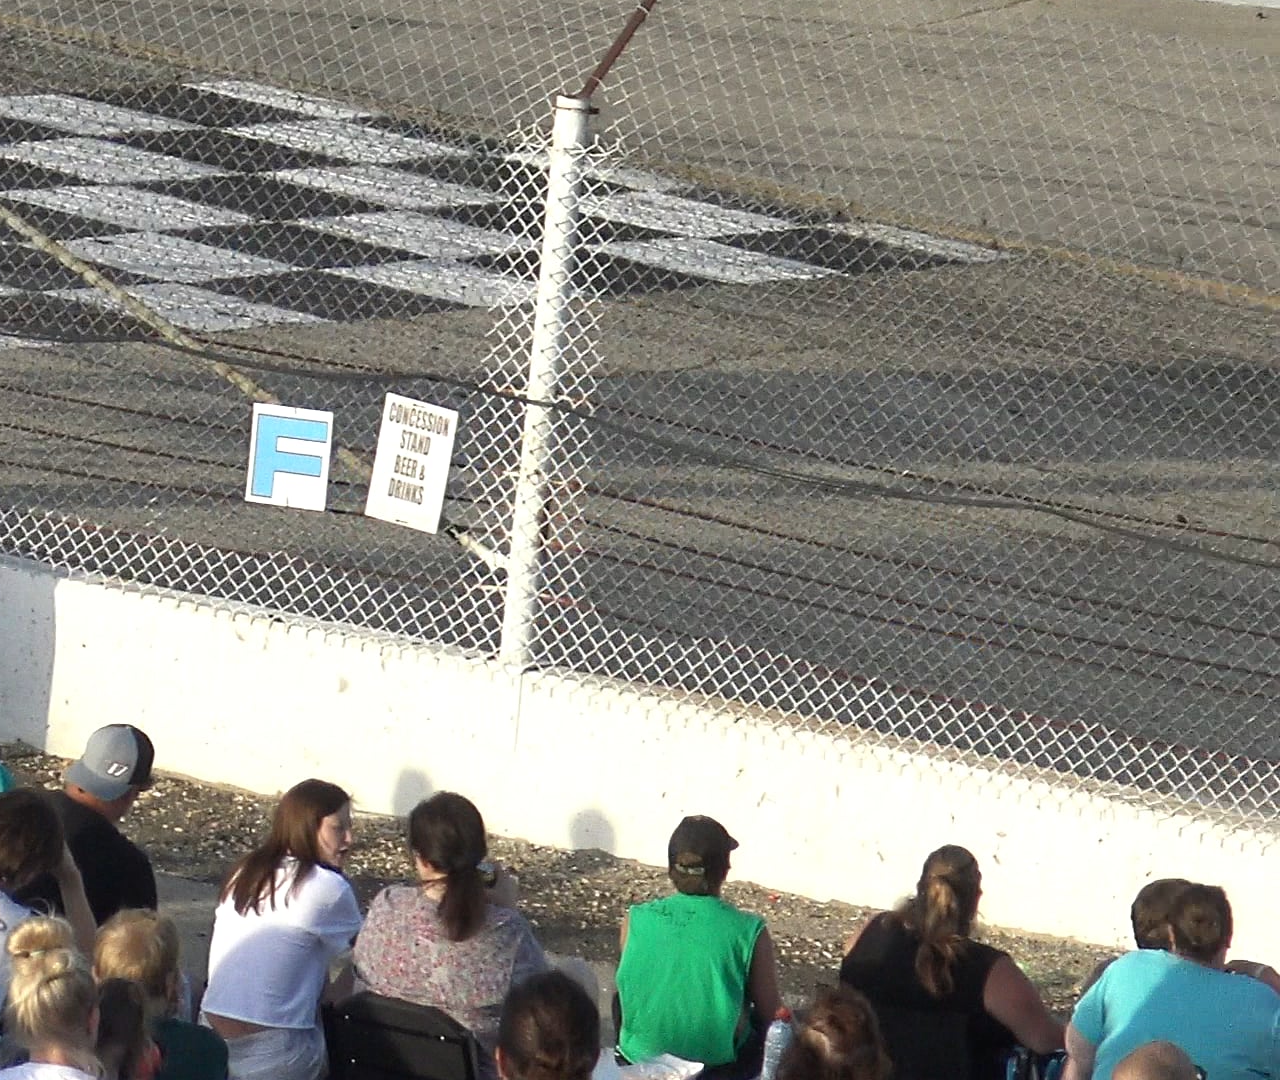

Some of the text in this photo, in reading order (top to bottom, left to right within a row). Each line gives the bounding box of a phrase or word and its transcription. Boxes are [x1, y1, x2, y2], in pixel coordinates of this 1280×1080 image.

[389, 402, 450, 437] CONCESSION
[251, 414, 328, 498] F
[400, 429, 431, 455] STAND
[394, 454, 425, 481] BEER &
[388, 477, 424, 505] DRINKS
